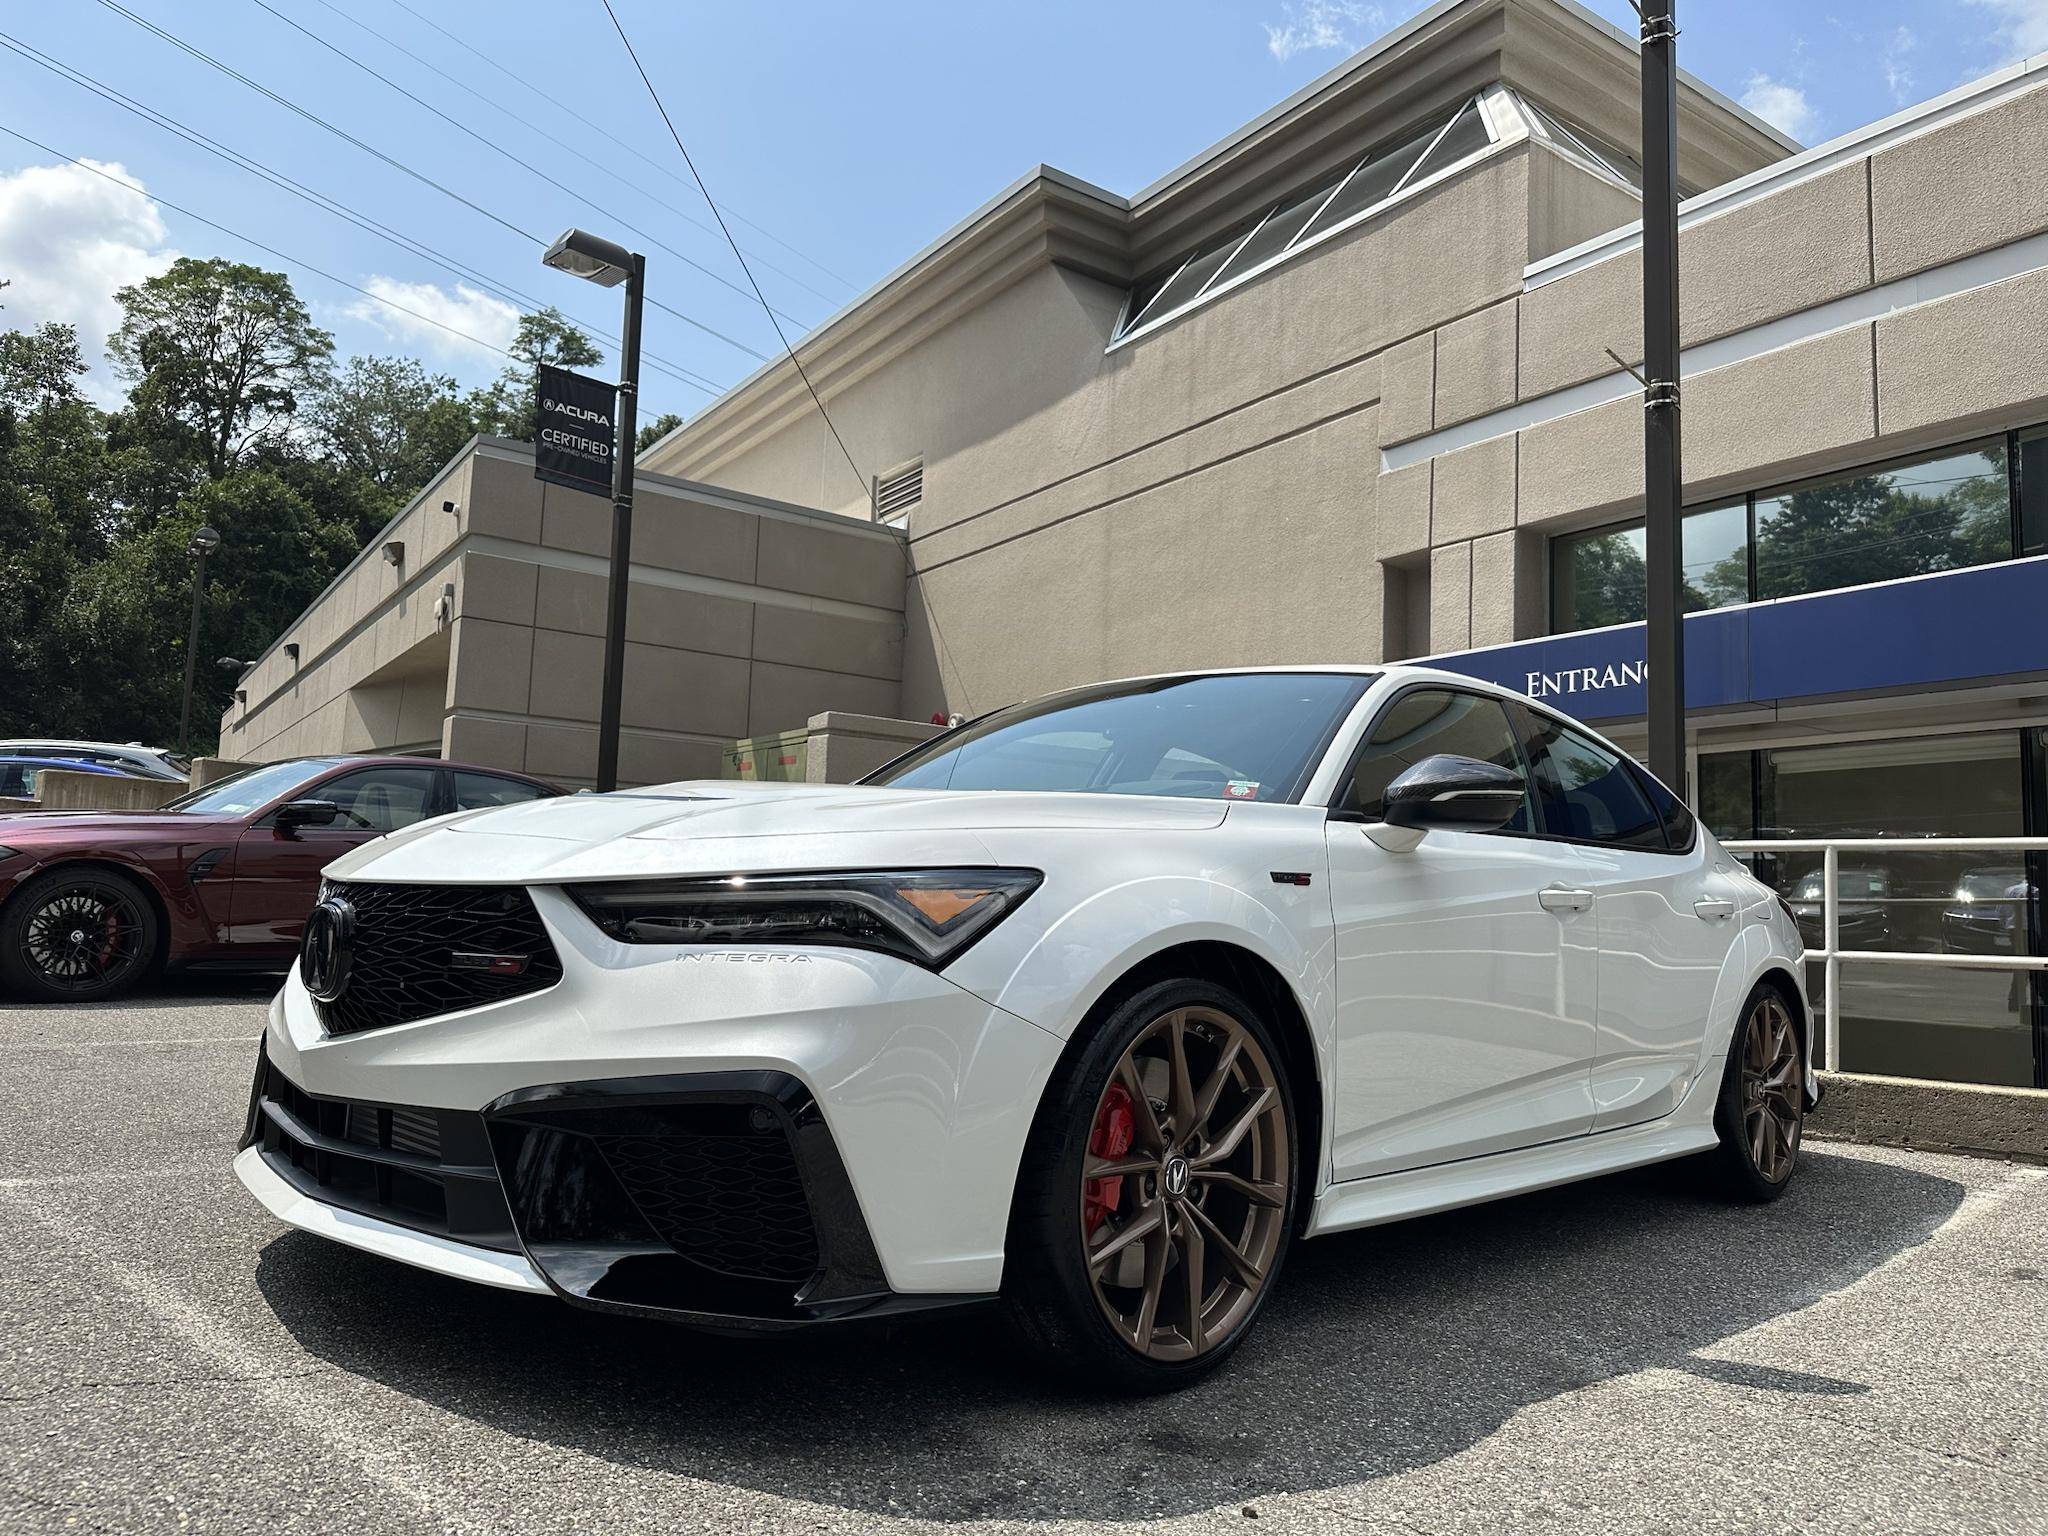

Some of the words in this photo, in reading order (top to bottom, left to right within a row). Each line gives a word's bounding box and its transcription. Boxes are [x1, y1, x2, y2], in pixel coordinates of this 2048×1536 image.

[554, 402, 610, 427] ACURA
[541, 428, 609, 456] CERTIFIED
[1525, 660, 1648, 698] ENTRAN
[675, 953, 812, 964] INTEGRA
